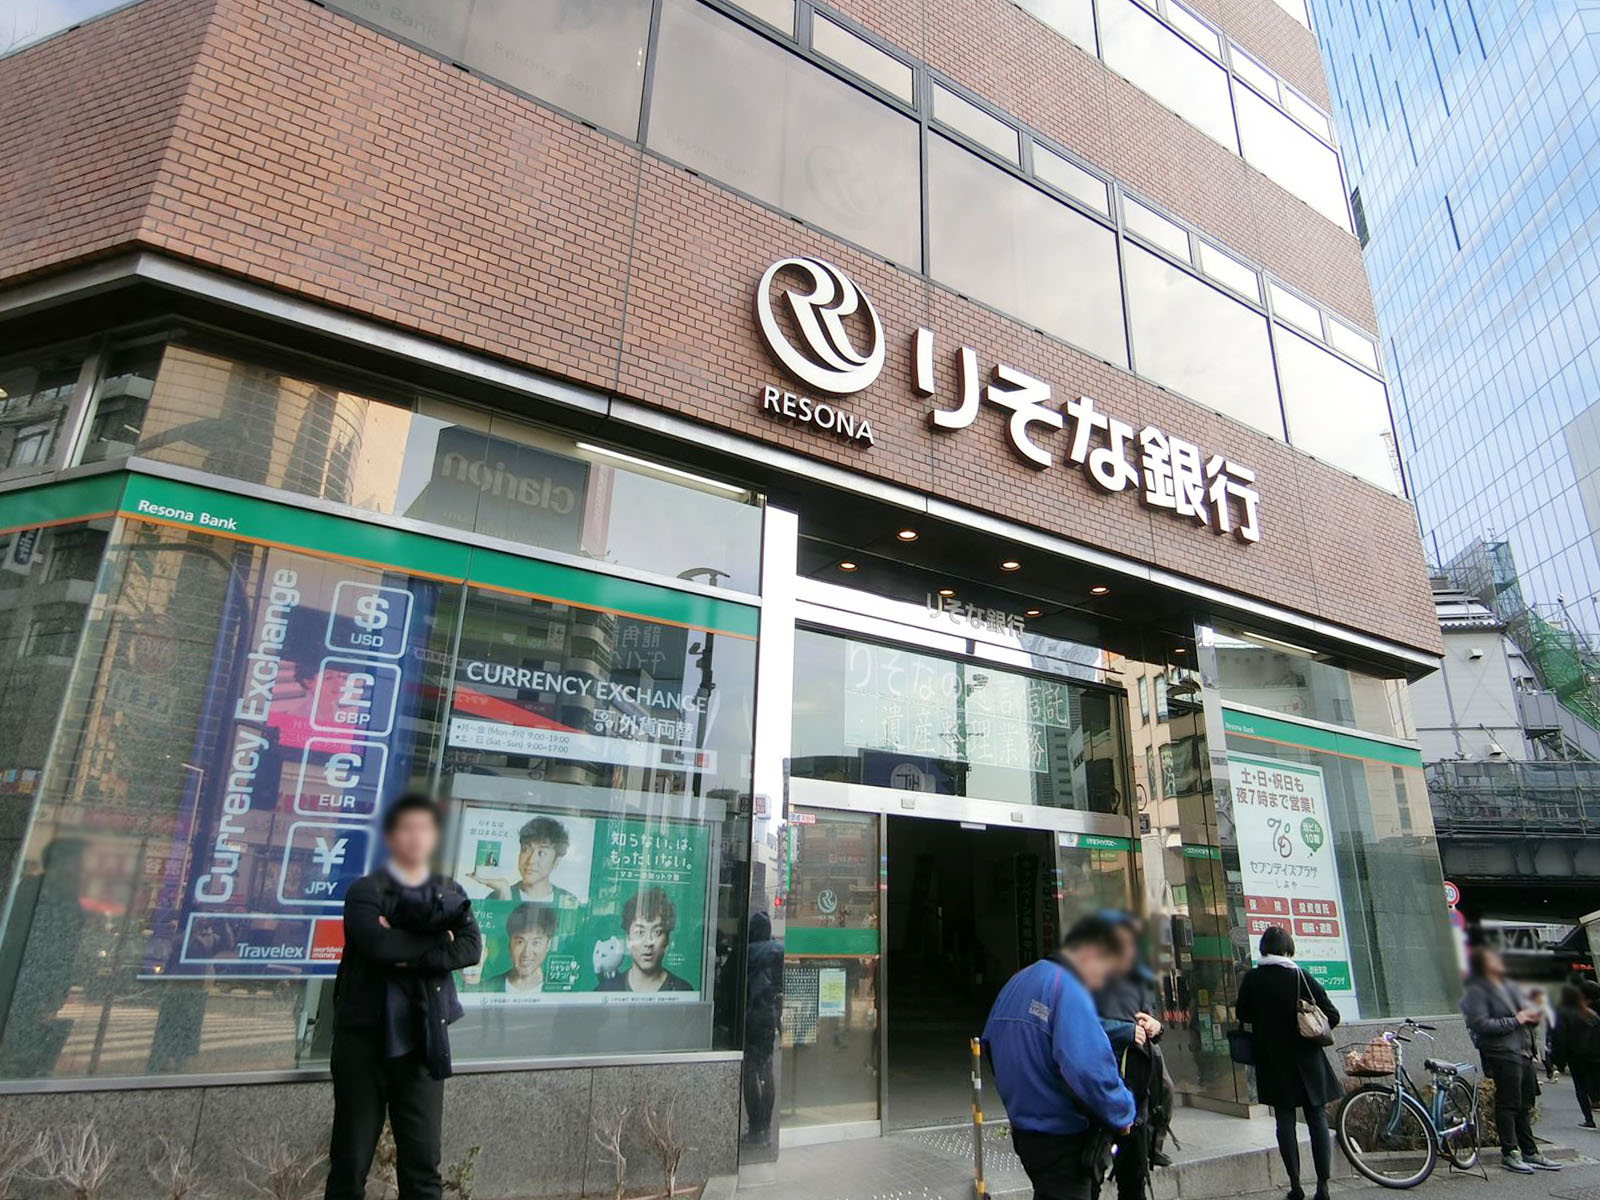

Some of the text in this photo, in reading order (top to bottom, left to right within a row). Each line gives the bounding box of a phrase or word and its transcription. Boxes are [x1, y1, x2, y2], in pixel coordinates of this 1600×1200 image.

[763, 384, 875, 447] RESONA
[911, 327, 1261, 544] りそな銀行
[137, 499, 238, 531] Resona Bank
[926, 592, 1026, 640] りそな銀行
[350, 632, 384, 649] USD
[466, 661, 592, 697] CURRENCY
[596, 680, 708, 714] EXCHANGE
[334, 711, 371, 726] GBP
[619, 714, 694, 742] 外貨両替
[194, 568, 300, 905] Currency Exchange
[1241, 768, 1305, 793] 土・日・祝日も
[319, 793, 356, 809] EUR
[610, 850, 693, 871] もったいない。
[305, 881, 338, 896] JPY
[236, 942, 304, 959] Travelex
